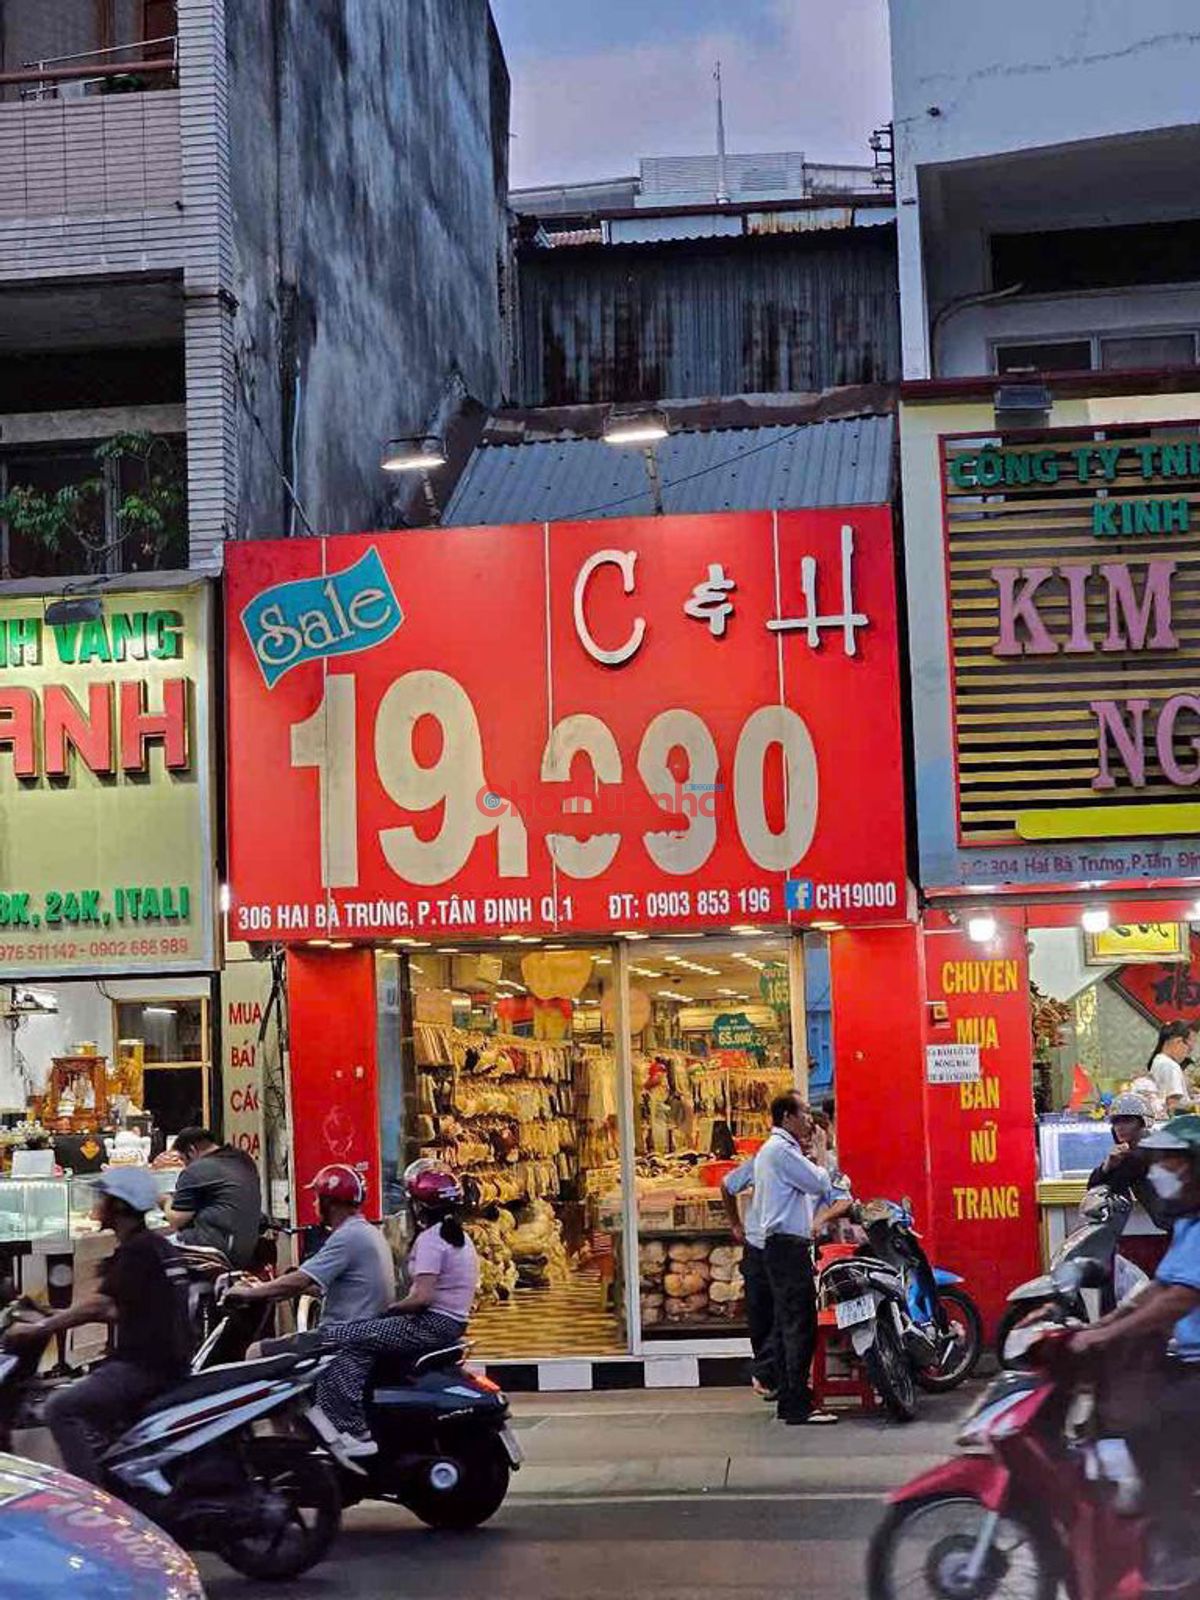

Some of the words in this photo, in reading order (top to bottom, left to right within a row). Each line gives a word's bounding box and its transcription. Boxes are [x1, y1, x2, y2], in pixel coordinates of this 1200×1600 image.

[950, 444, 1059, 487] CÔNG
[1073, 447, 1119, 483] TY
[1093, 500, 1188, 536] KINH
[257, 579, 391, 665] Sale
[573, 550, 646, 664] C
[684, 563, 736, 635] &
[992, 561, 1180, 655] KIM
[0, 619, 41, 667] H
[114, 886, 190, 920] ITALI
[239, 906, 271, 930] 306
[277, 905, 309, 929] HAI
[315, 897, 340, 928] BÀ
[484, 896, 532, 927] ĐỊNH
[609, 892, 639, 919] ĐT:
[646, 891, 690, 917] 0903
[697, 889, 730, 915] 853
[738, 887, 770, 913] 196
[816, 882, 897, 909] CH19000
[229, 1002, 262, 1025] MUA
[957, 1017, 1000, 1049] MUA
[970, 1120, 999, 1163] NỮ
[953, 1186, 1019, 1220] TRANG
